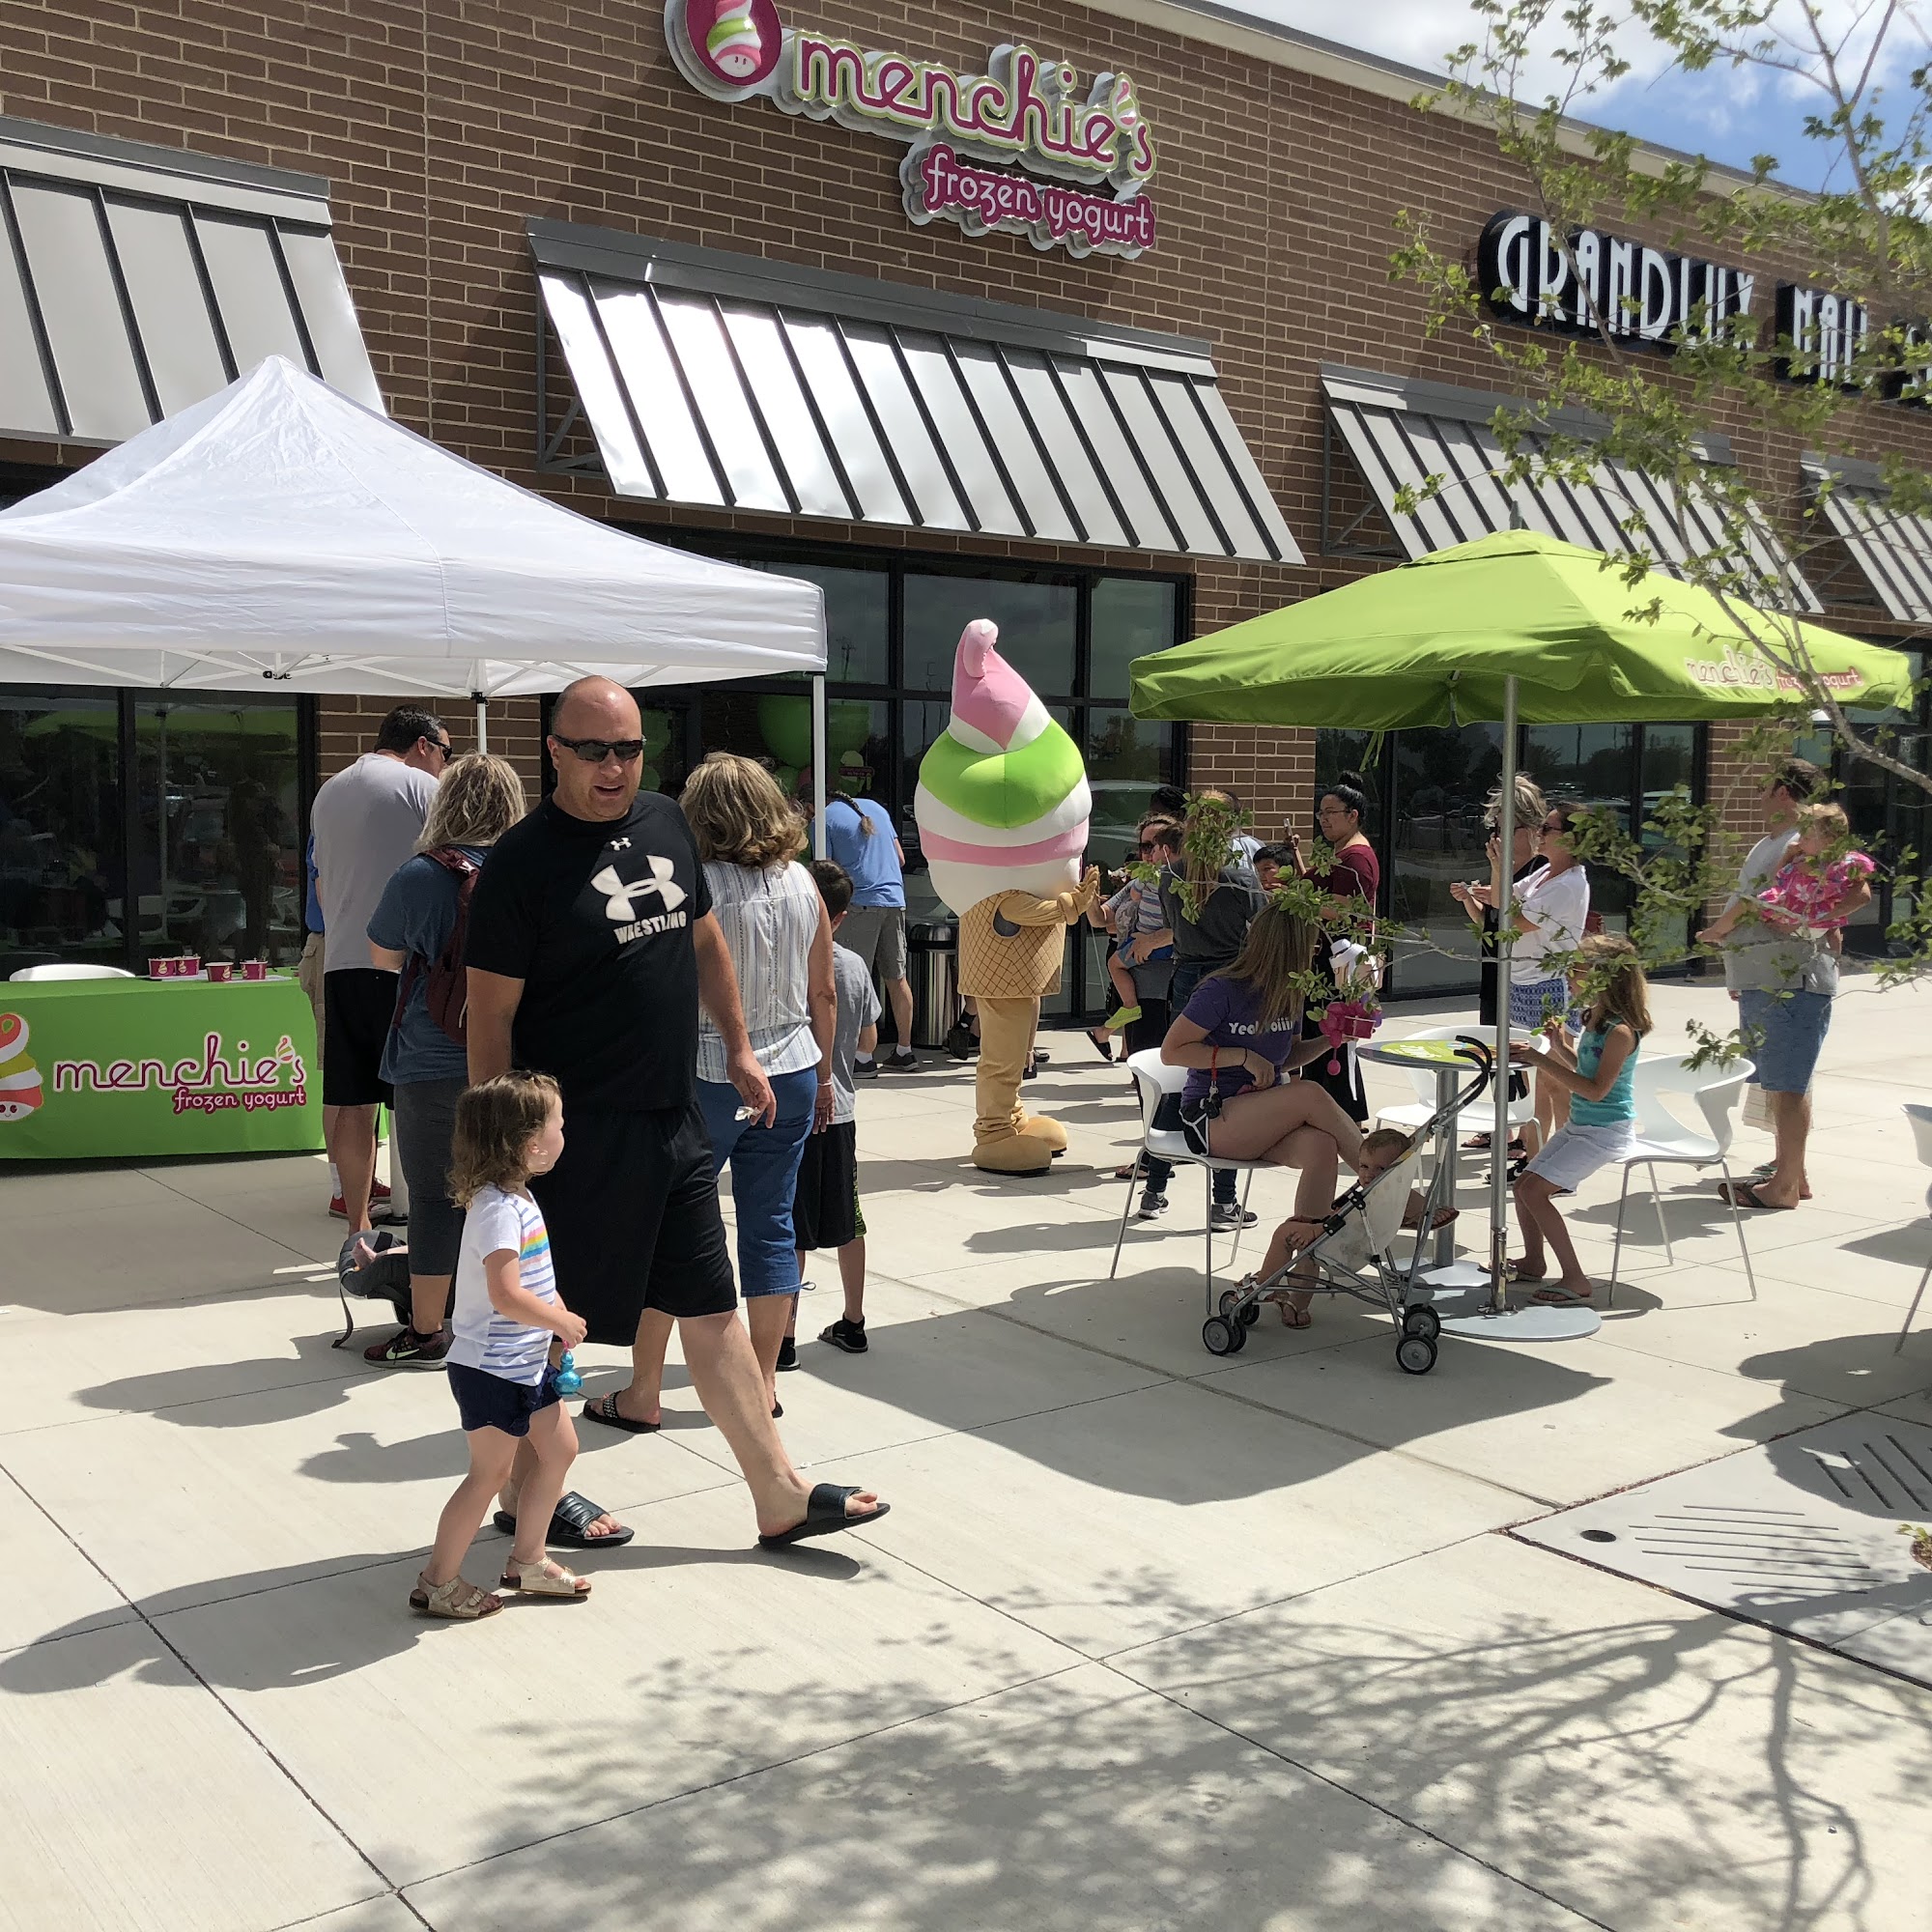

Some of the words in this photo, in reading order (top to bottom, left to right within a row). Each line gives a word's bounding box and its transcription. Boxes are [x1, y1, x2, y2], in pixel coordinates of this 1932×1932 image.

[800, 36, 1153, 174] menchie's
[926, 151, 1037, 217] frozen
[1048, 194, 1150, 240] yogurt
[1812, 668, 1864, 691] ogurt
[56, 1034, 305, 1090] menchie's
[174, 1089, 238, 1112] frozen
[244, 1087, 304, 1109] yogurt
